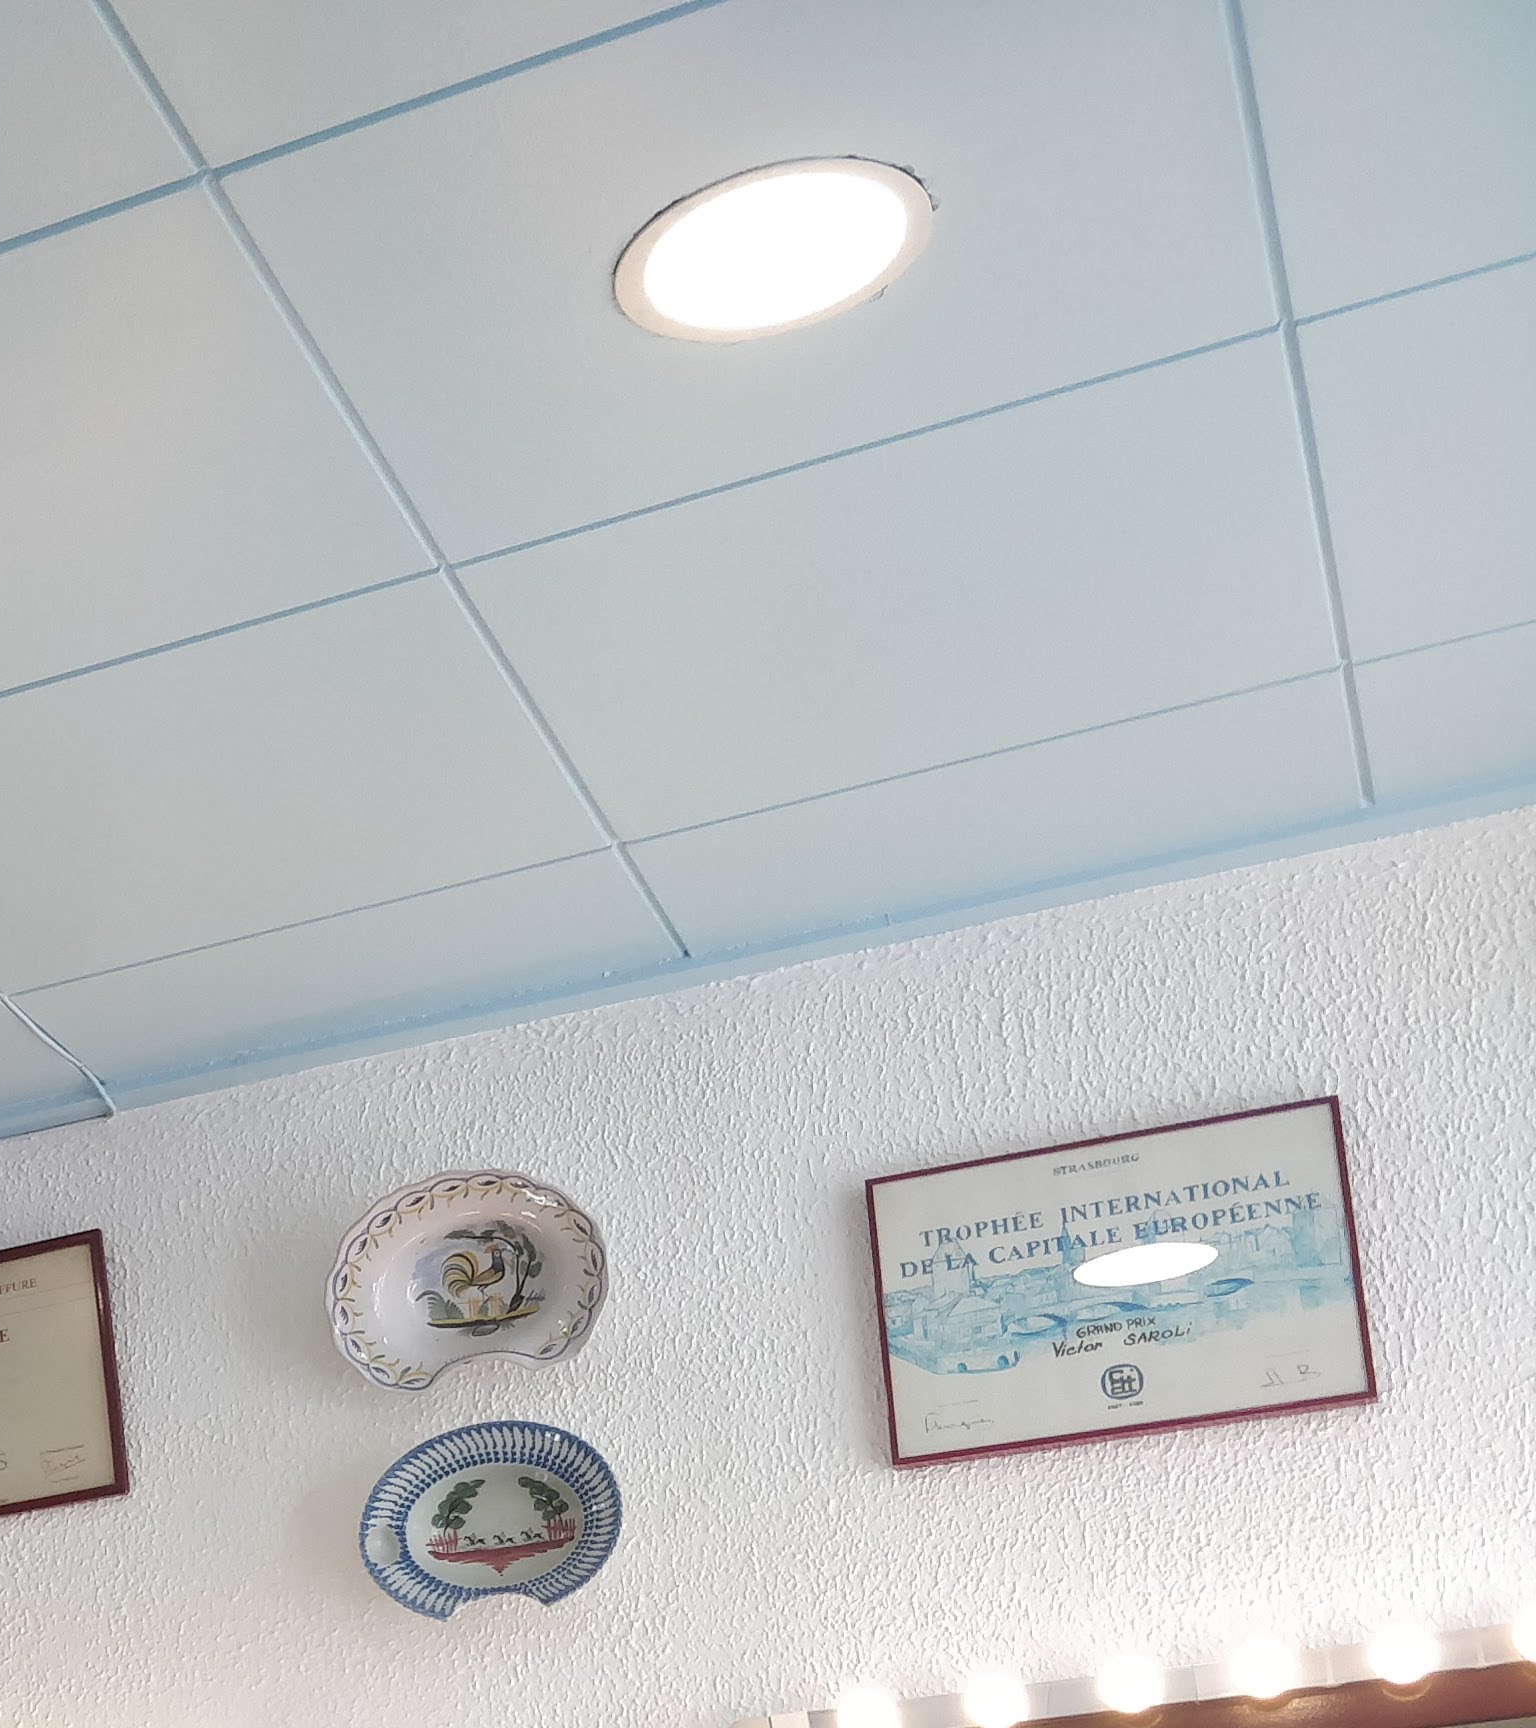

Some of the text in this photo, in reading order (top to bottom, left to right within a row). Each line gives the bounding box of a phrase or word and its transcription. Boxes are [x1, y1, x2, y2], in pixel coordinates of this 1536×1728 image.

[1052, 1153, 1140, 1177] STRASBOURG
[919, 1170, 1290, 1247] TROPHÉE INTERNATIONAL
[900, 1192, 1322, 1279] DE LA CAPITALE EUROPÉENNE
[1076, 1322, 1123, 1339] GRAND
[1051, 1341, 1103, 1358] Victor
